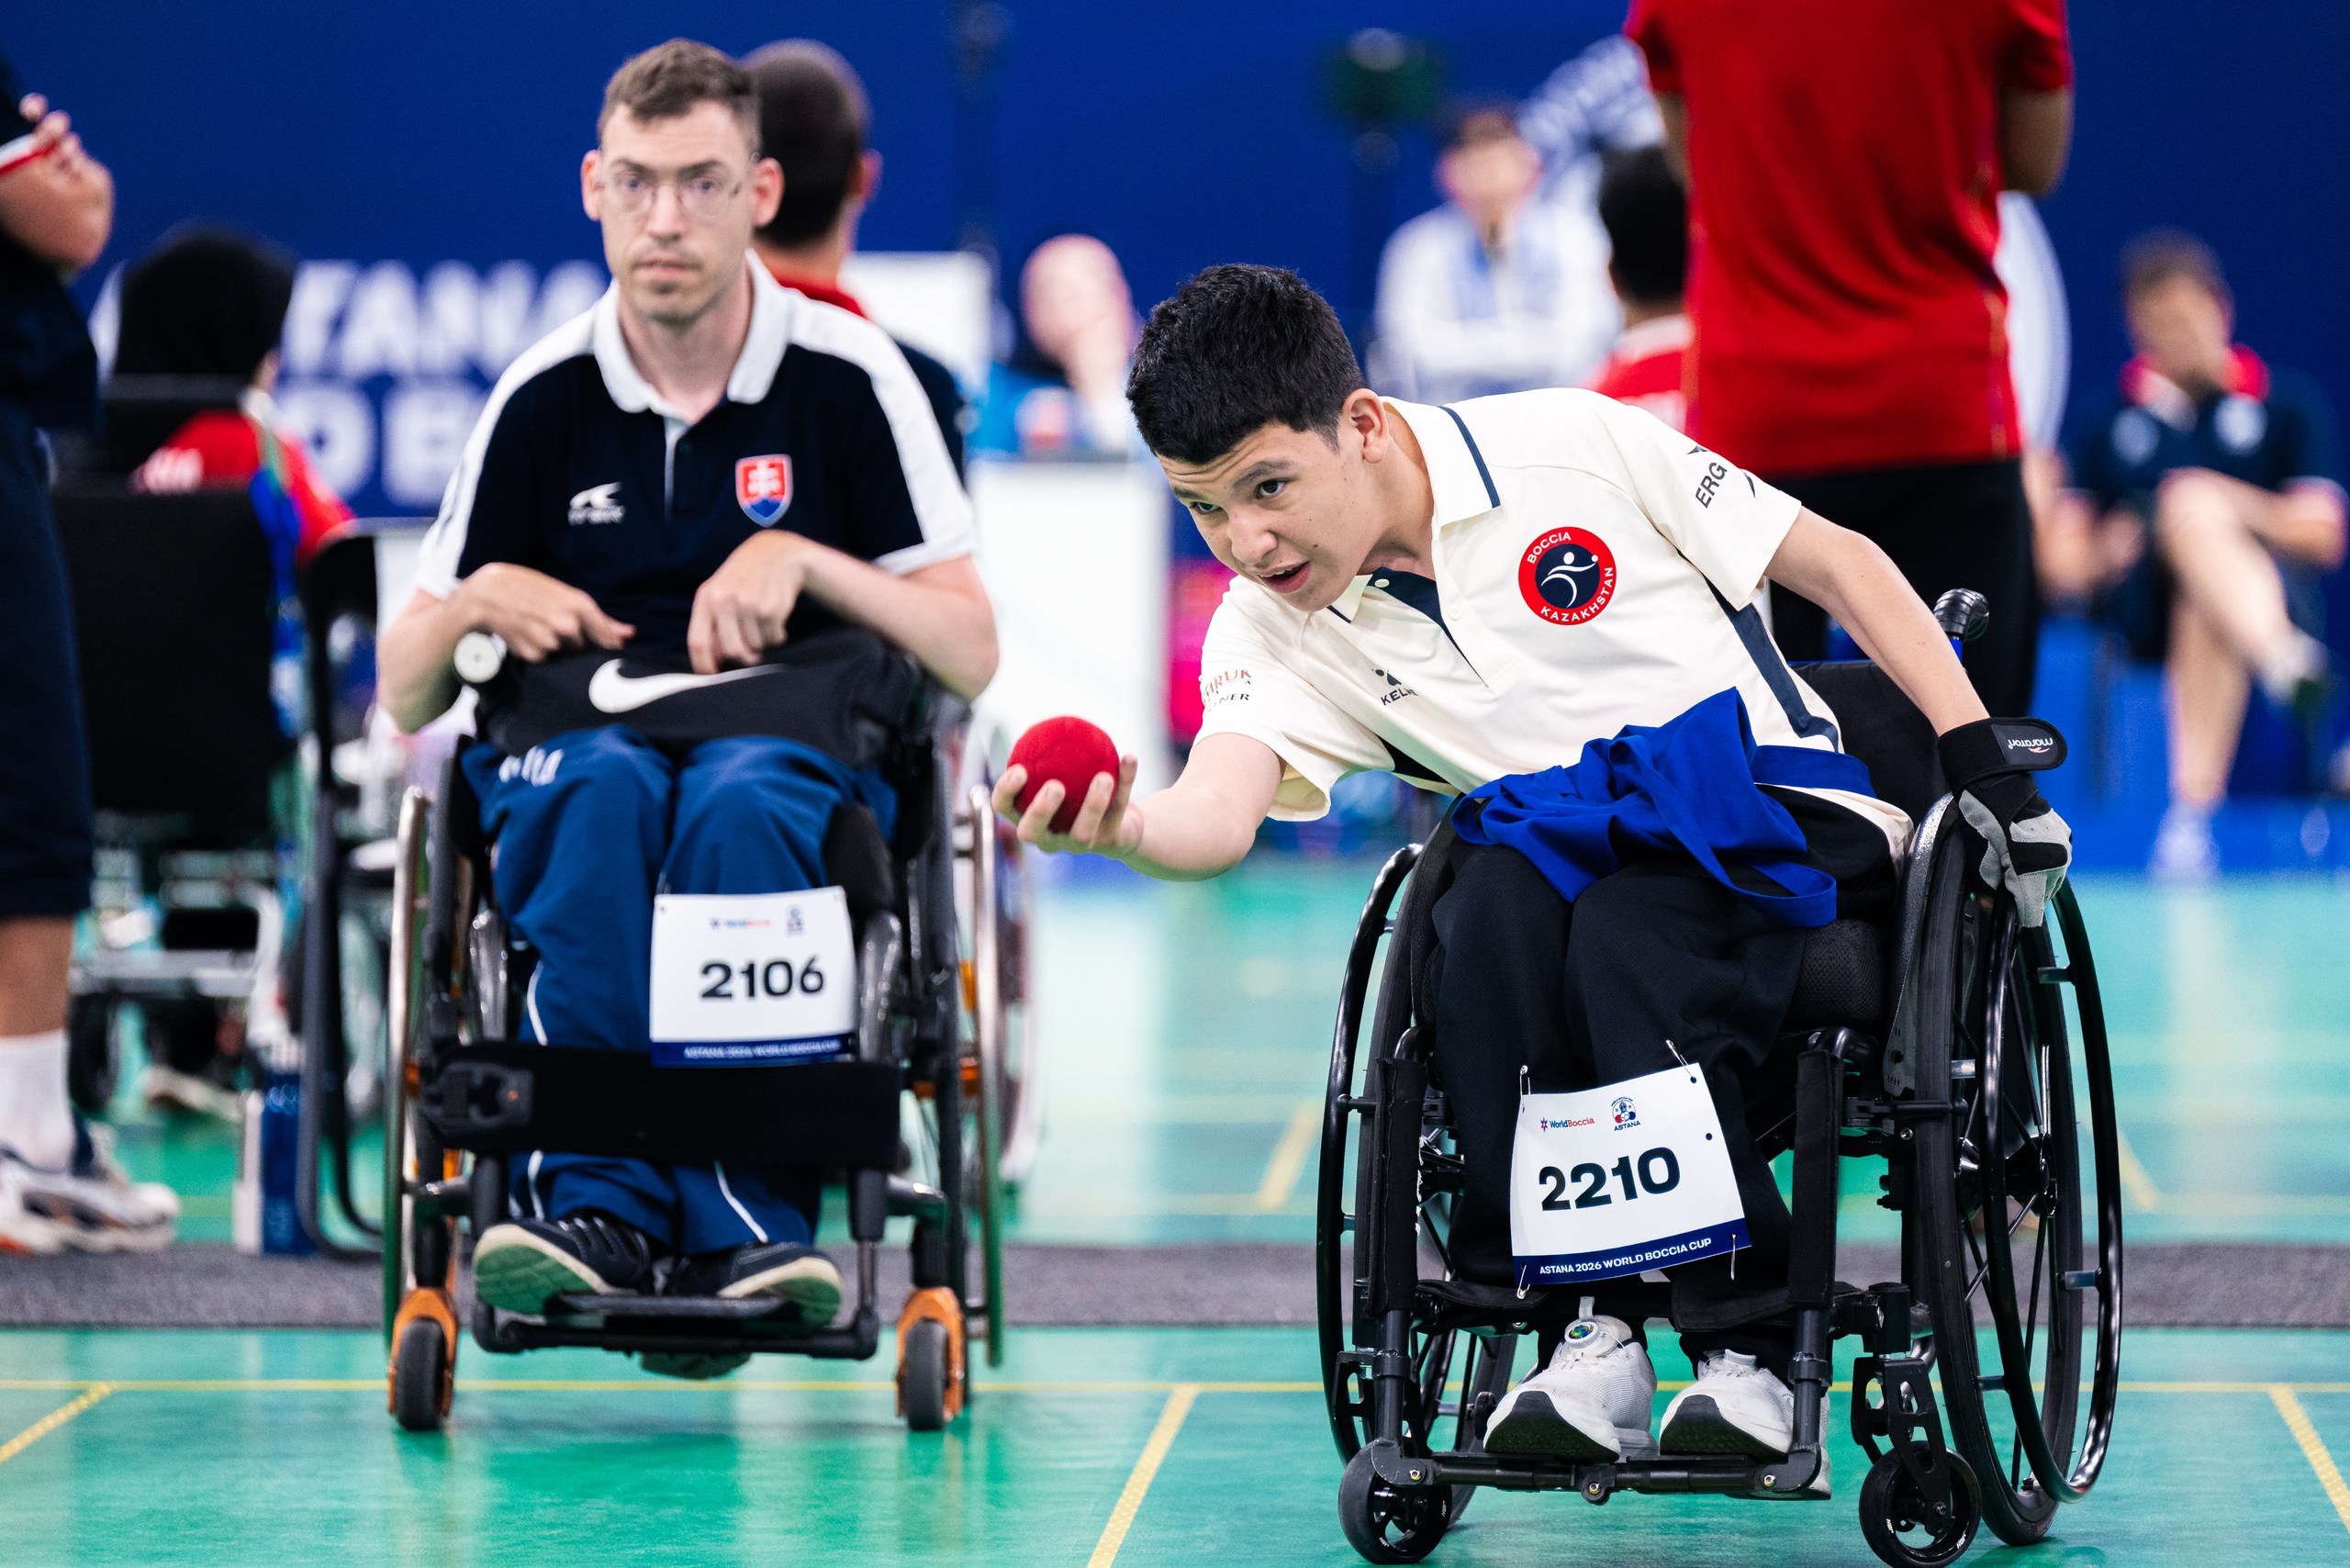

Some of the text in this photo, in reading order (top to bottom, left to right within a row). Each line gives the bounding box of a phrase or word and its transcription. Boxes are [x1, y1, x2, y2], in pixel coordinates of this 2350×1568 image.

[1695, 462, 1728, 509] ERG
[1527, 532, 1572, 565] BOCCIA
[1540, 567, 1613, 622] KAZAKHSTAN
[701, 956, 823, 999] 2106
[1550, 1117, 1595, 1129] WorldBoccia
[1614, 1120, 1641, 1131] ASTANA
[1539, 1147, 1681, 1211] 2210
[1539, 1238, 1712, 1274] ASTANA 2026 WORLD BOCCIA CUP
